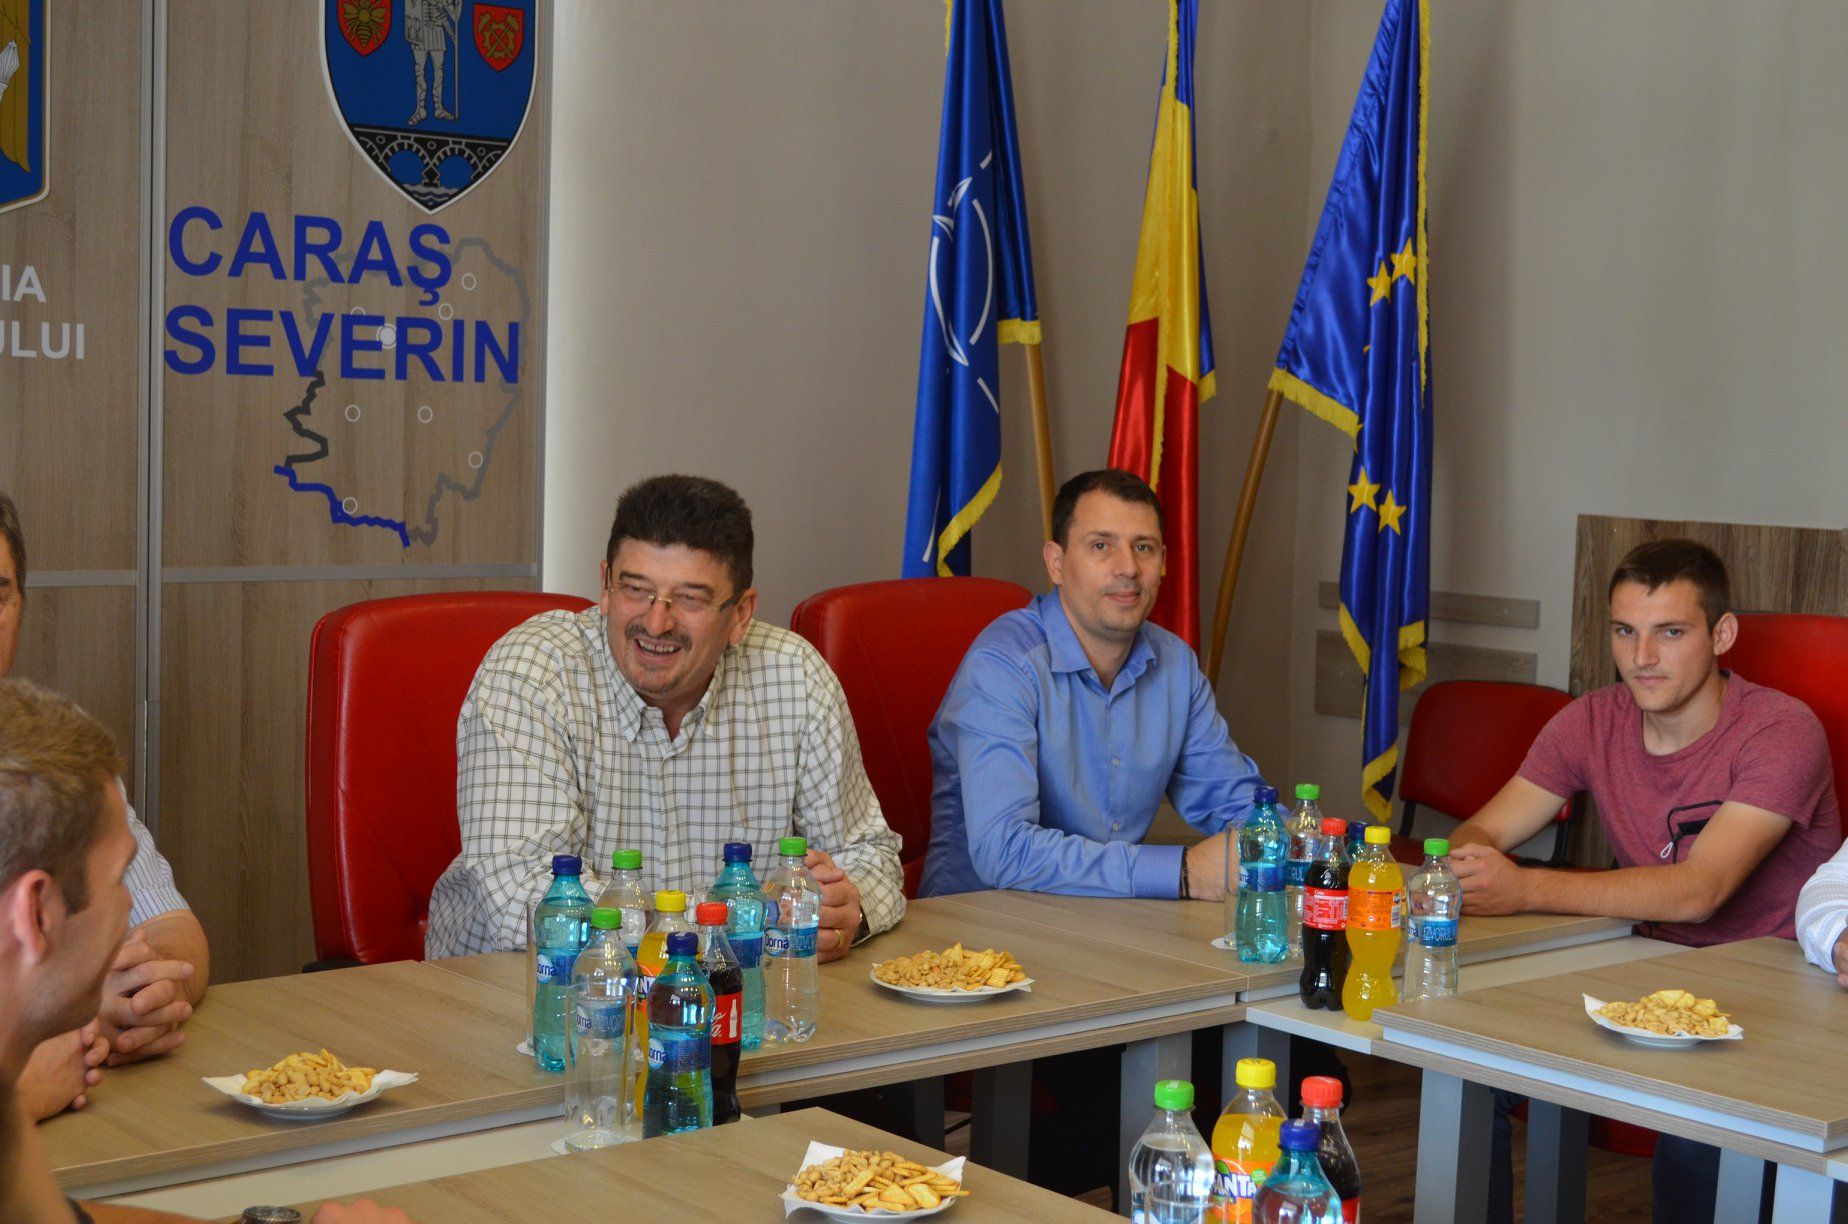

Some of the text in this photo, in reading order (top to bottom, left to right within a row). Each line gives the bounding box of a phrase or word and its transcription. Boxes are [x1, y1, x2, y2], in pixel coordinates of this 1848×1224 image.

[0, 320, 84, 359] LUI
[164, 304, 520, 384] SEVERIN
[537, 962, 557, 977] orna
[576, 1014, 593, 1029] orna
[649, 1047, 668, 1061] orna
[1213, 1172, 1257, 1198] ANTA
